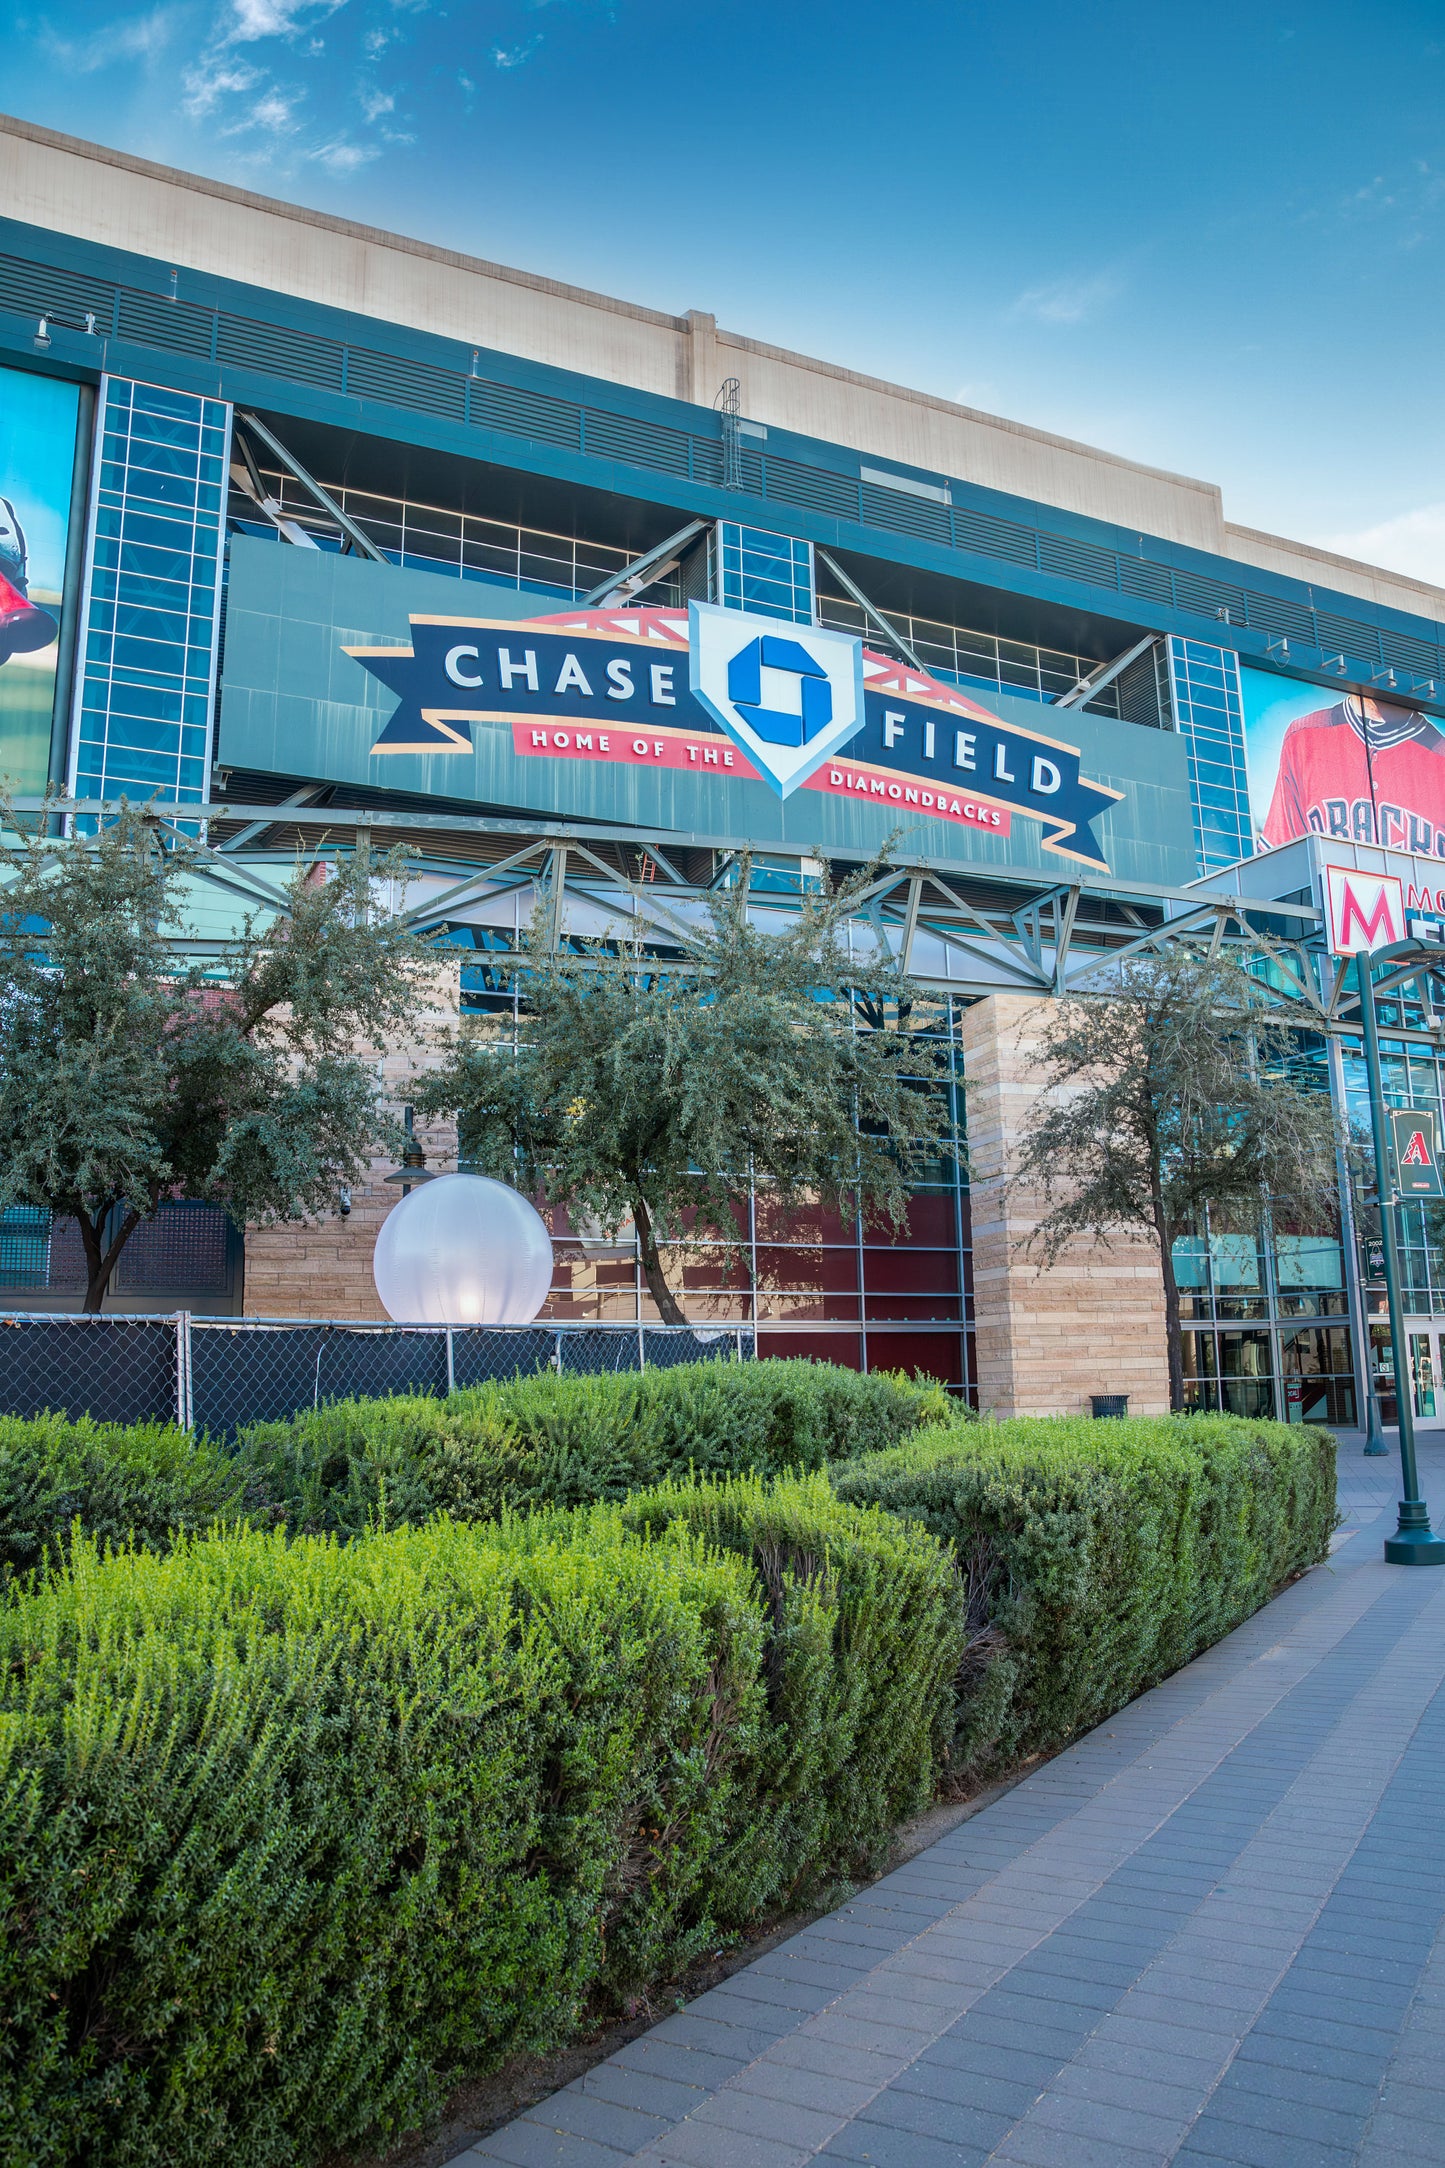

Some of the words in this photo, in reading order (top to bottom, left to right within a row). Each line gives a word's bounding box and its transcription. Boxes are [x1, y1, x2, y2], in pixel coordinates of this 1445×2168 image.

[444, 645, 676, 705] CHASE
[882, 710, 1061, 794] FIELD
[531, 730, 610, 752] HOME
[632, 739, 664, 757] OF
[686, 745, 734, 766] THE
[830, 770, 1001, 826] DIAMONDBACKS
[1340, 877, 1397, 947] M
